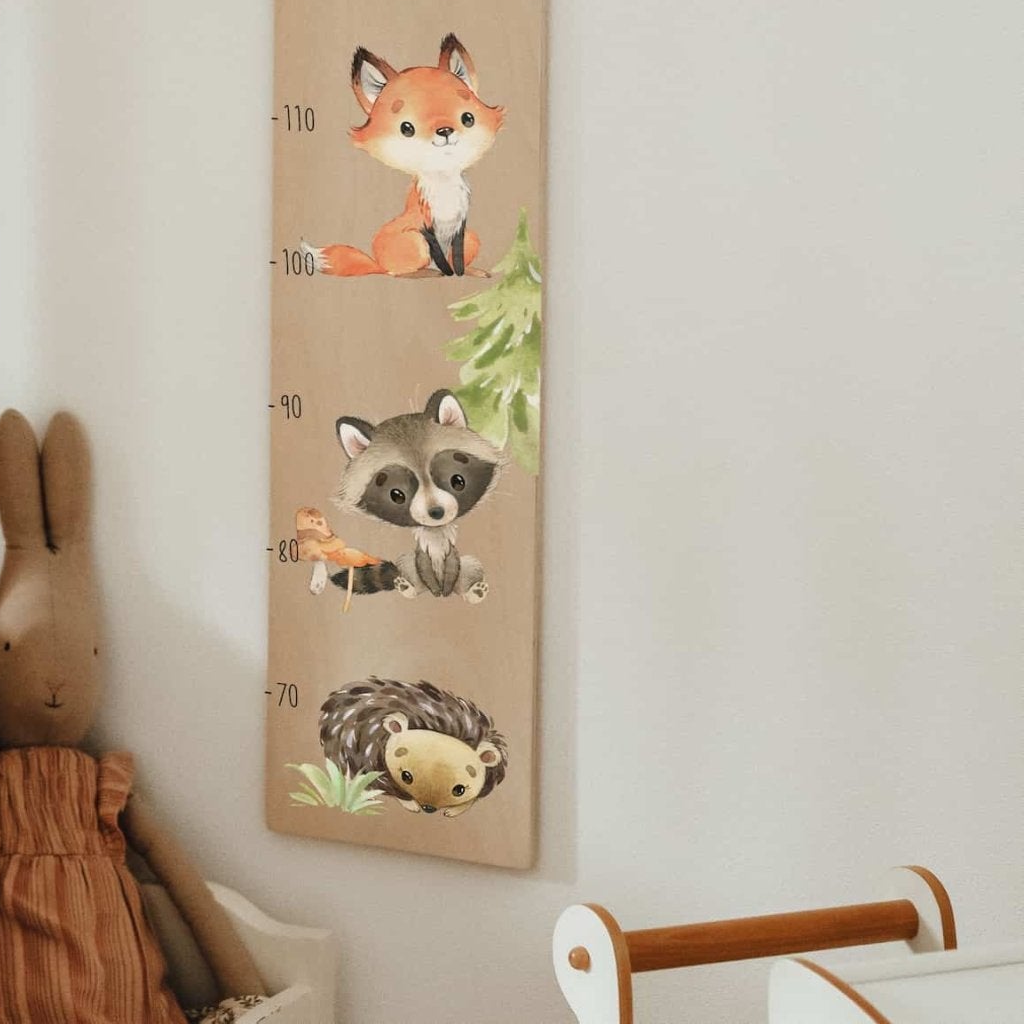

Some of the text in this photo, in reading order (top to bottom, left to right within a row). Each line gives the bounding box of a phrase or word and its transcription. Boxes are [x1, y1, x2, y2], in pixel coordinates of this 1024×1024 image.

[284, 105, 315, 132] 110
[282, 249, 315, 276] 100
[279, 394, 302, 419] 90
[277, 538, 300, 563] 80
[275, 682, 299, 708] 70
